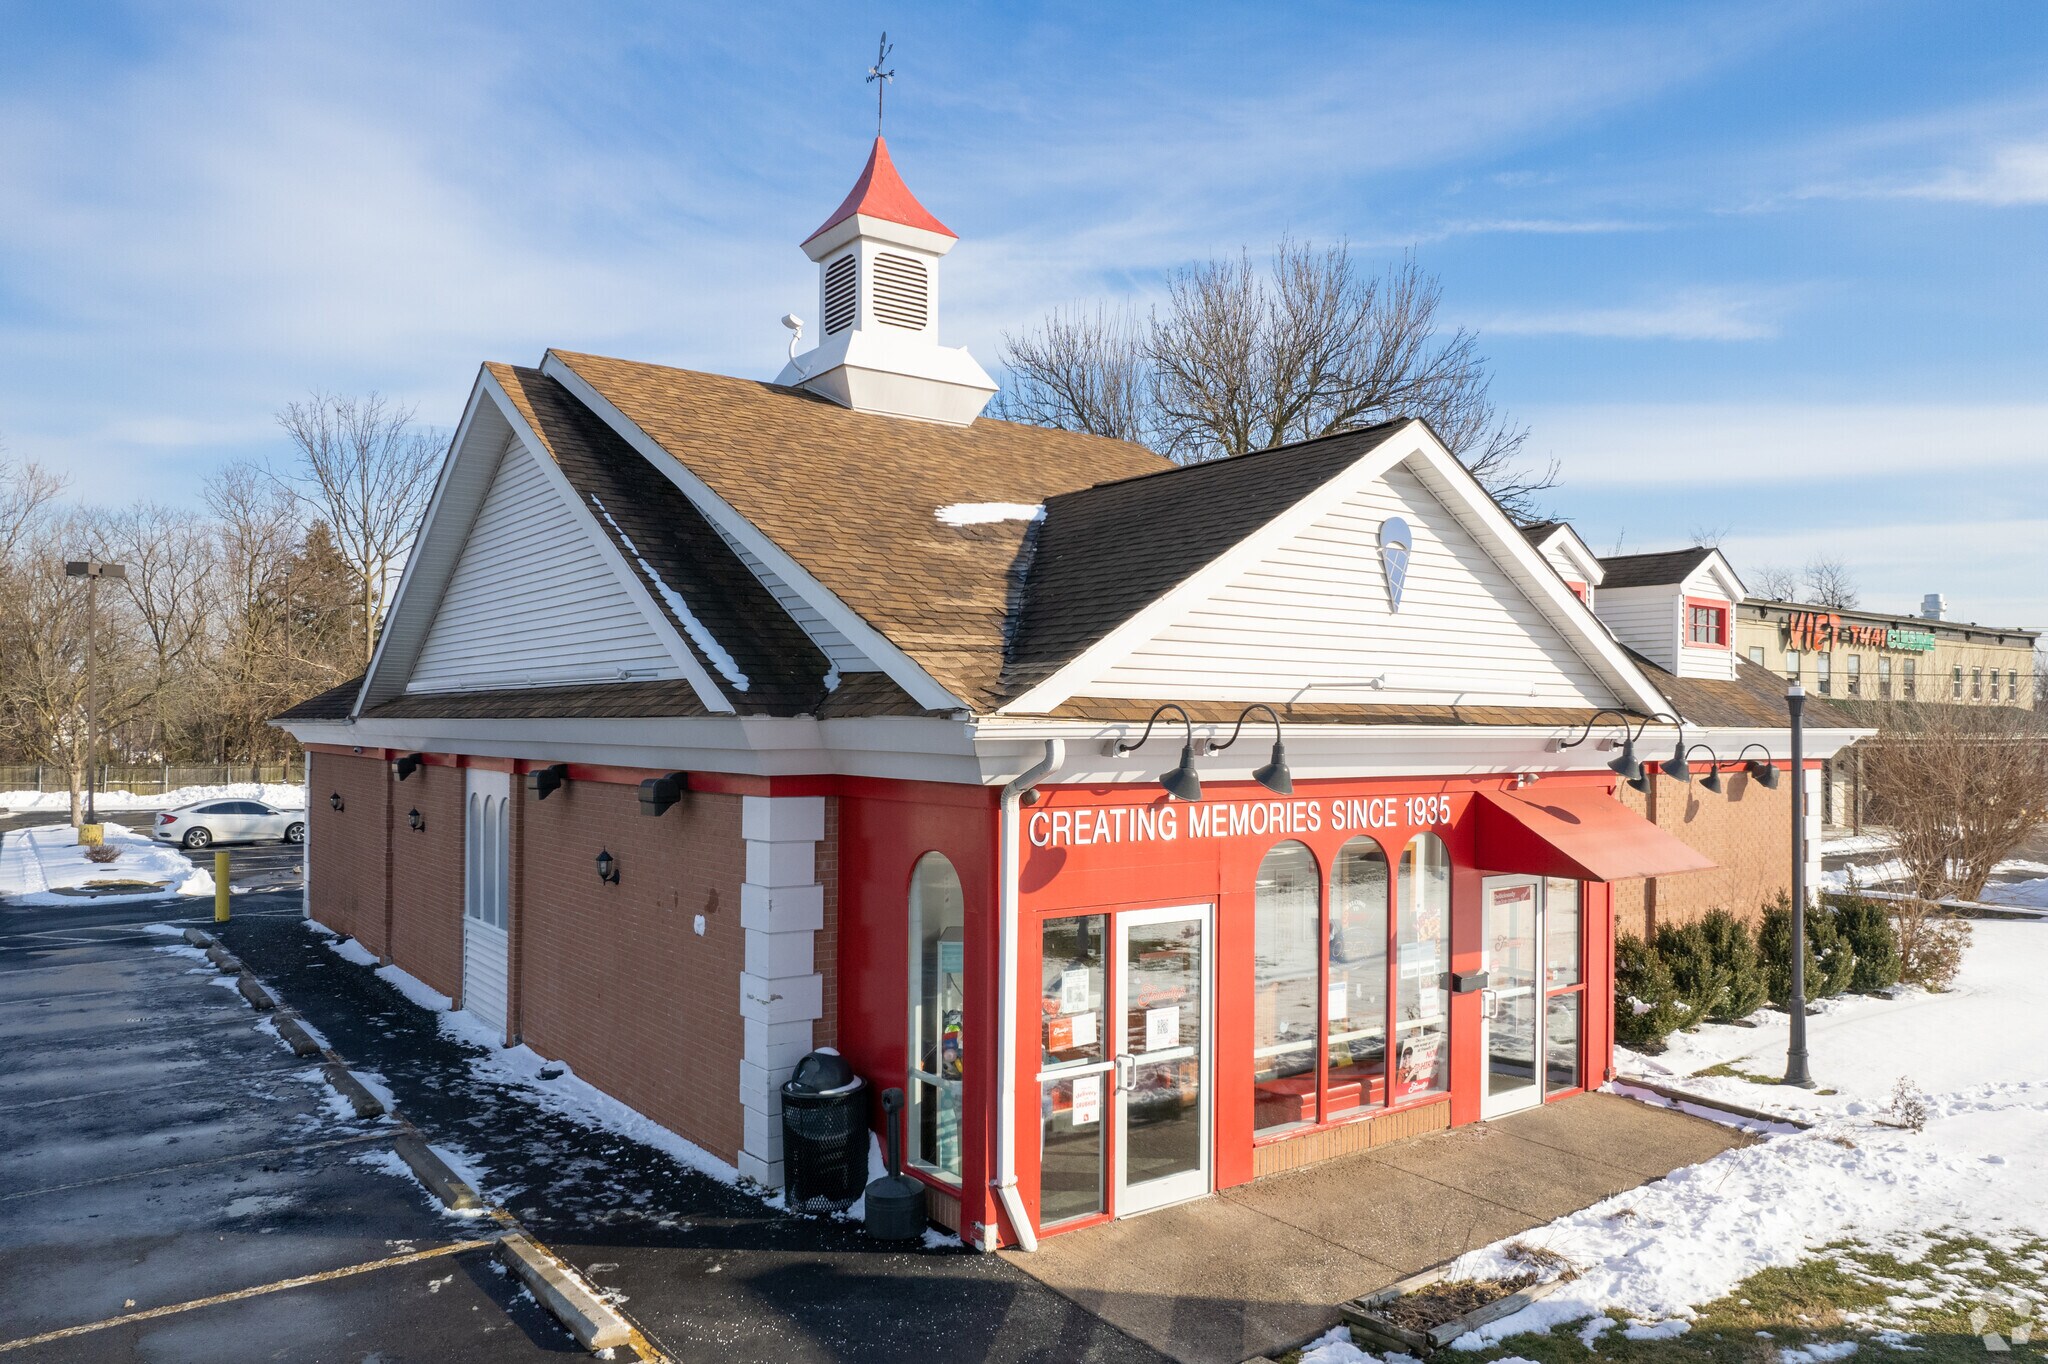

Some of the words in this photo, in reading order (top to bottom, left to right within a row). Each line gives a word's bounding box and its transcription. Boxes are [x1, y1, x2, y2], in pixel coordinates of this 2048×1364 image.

[1887, 629, 1936, 651] CUISINE
[1028, 805, 1177, 847] CREATING
[1188, 800, 1322, 839] MEMORIES
[1330, 797, 1397, 831] SINCE
[1403, 795, 1450, 827] 1935
